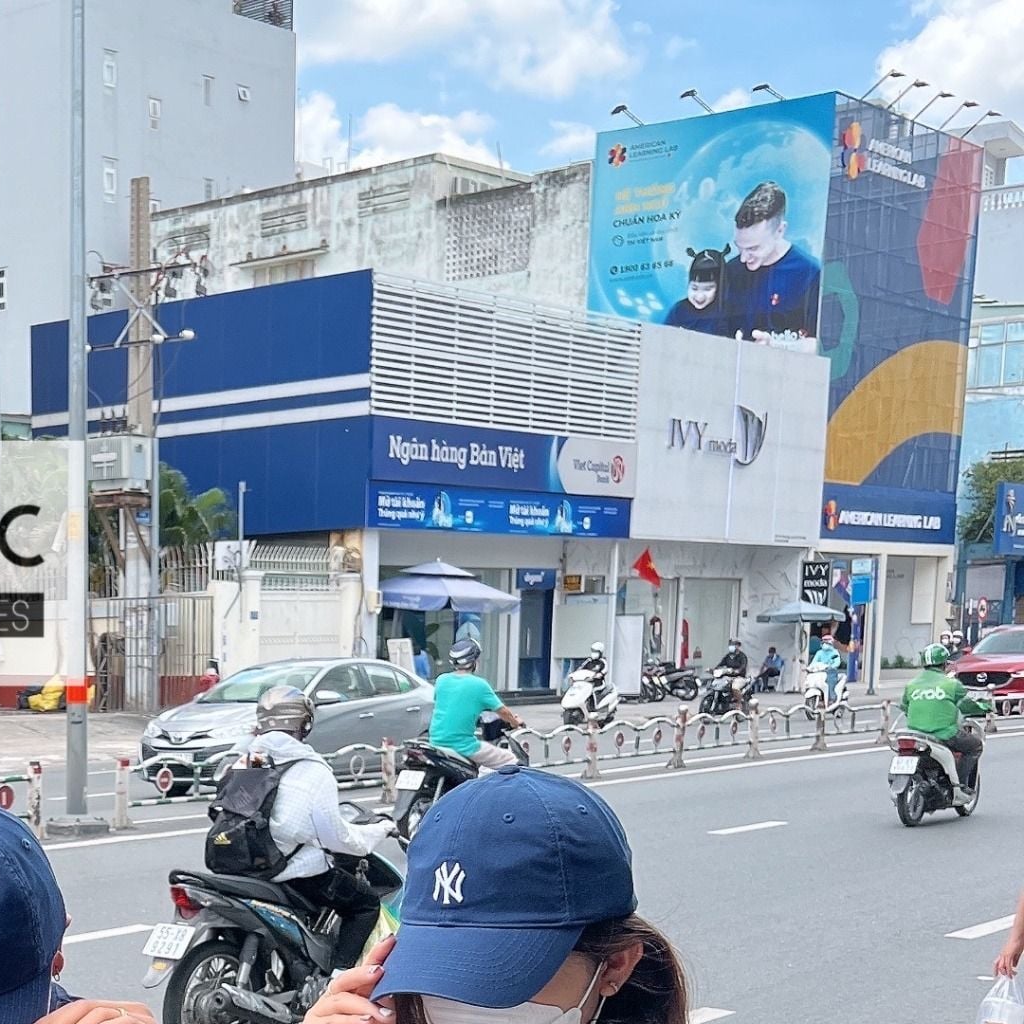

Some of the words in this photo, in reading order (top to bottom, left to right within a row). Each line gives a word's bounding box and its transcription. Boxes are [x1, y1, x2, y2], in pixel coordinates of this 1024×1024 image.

[667, 418, 709, 451] IVY
[388, 434, 429, 466] Ngân
[430, 439, 468, 470] hàng
[469, 442, 497, 467] Bản
[498, 445, 525, 473] Việt
[838, 510, 883, 526] AMERICAN
[883, 513, 922, 529] LEARNING
[922, 515, 942, 530] LAB
[805, 564, 829, 576] IVY
[803, 577, 828, 588] moda
